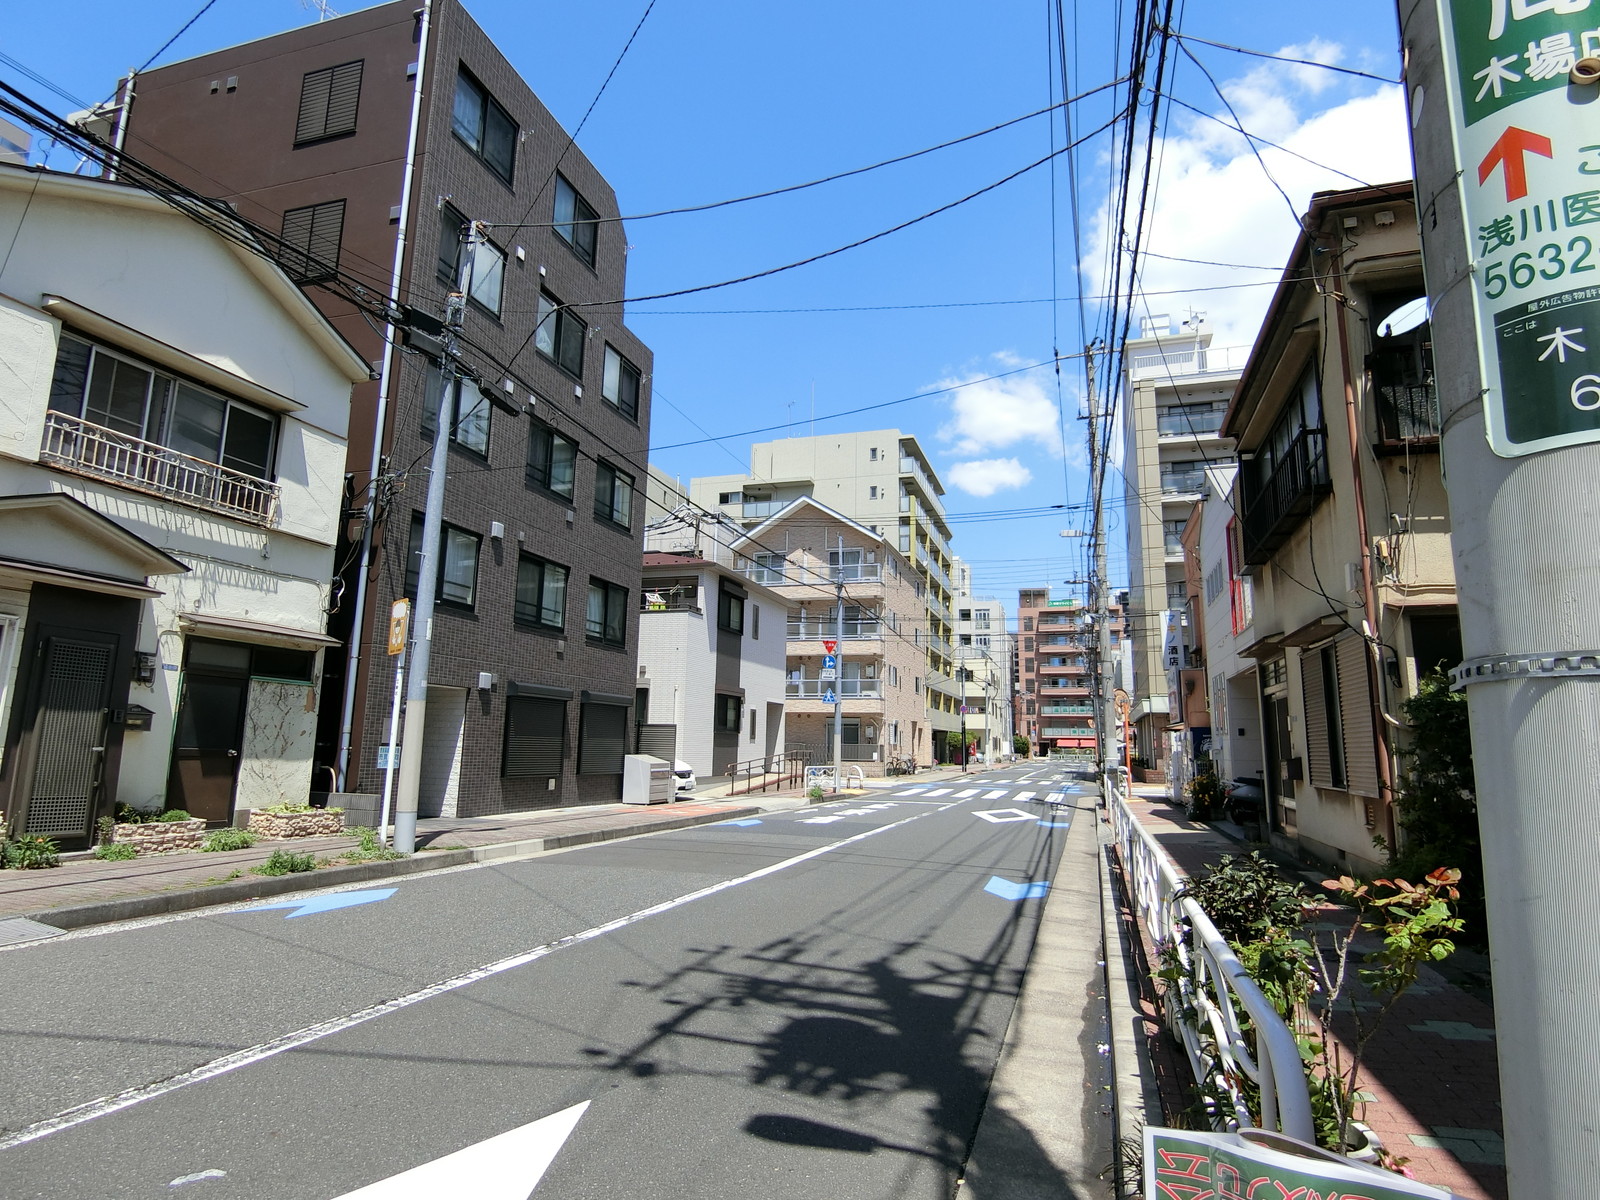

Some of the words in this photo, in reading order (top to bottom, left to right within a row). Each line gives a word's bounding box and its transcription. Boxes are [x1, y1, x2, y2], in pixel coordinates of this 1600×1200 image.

[1479, 190, 1600, 257] 浅川医
[1484, 235, 1600, 299] 5632
[1527, 286, 1600, 313] 屋外広告物許
[1503, 320, 1537, 338] ここは
[1536, 326, 1586, 363] 木
[1570, 374, 1600, 411] 6
[1166, 614, 1179, 666] マキノ酒店
